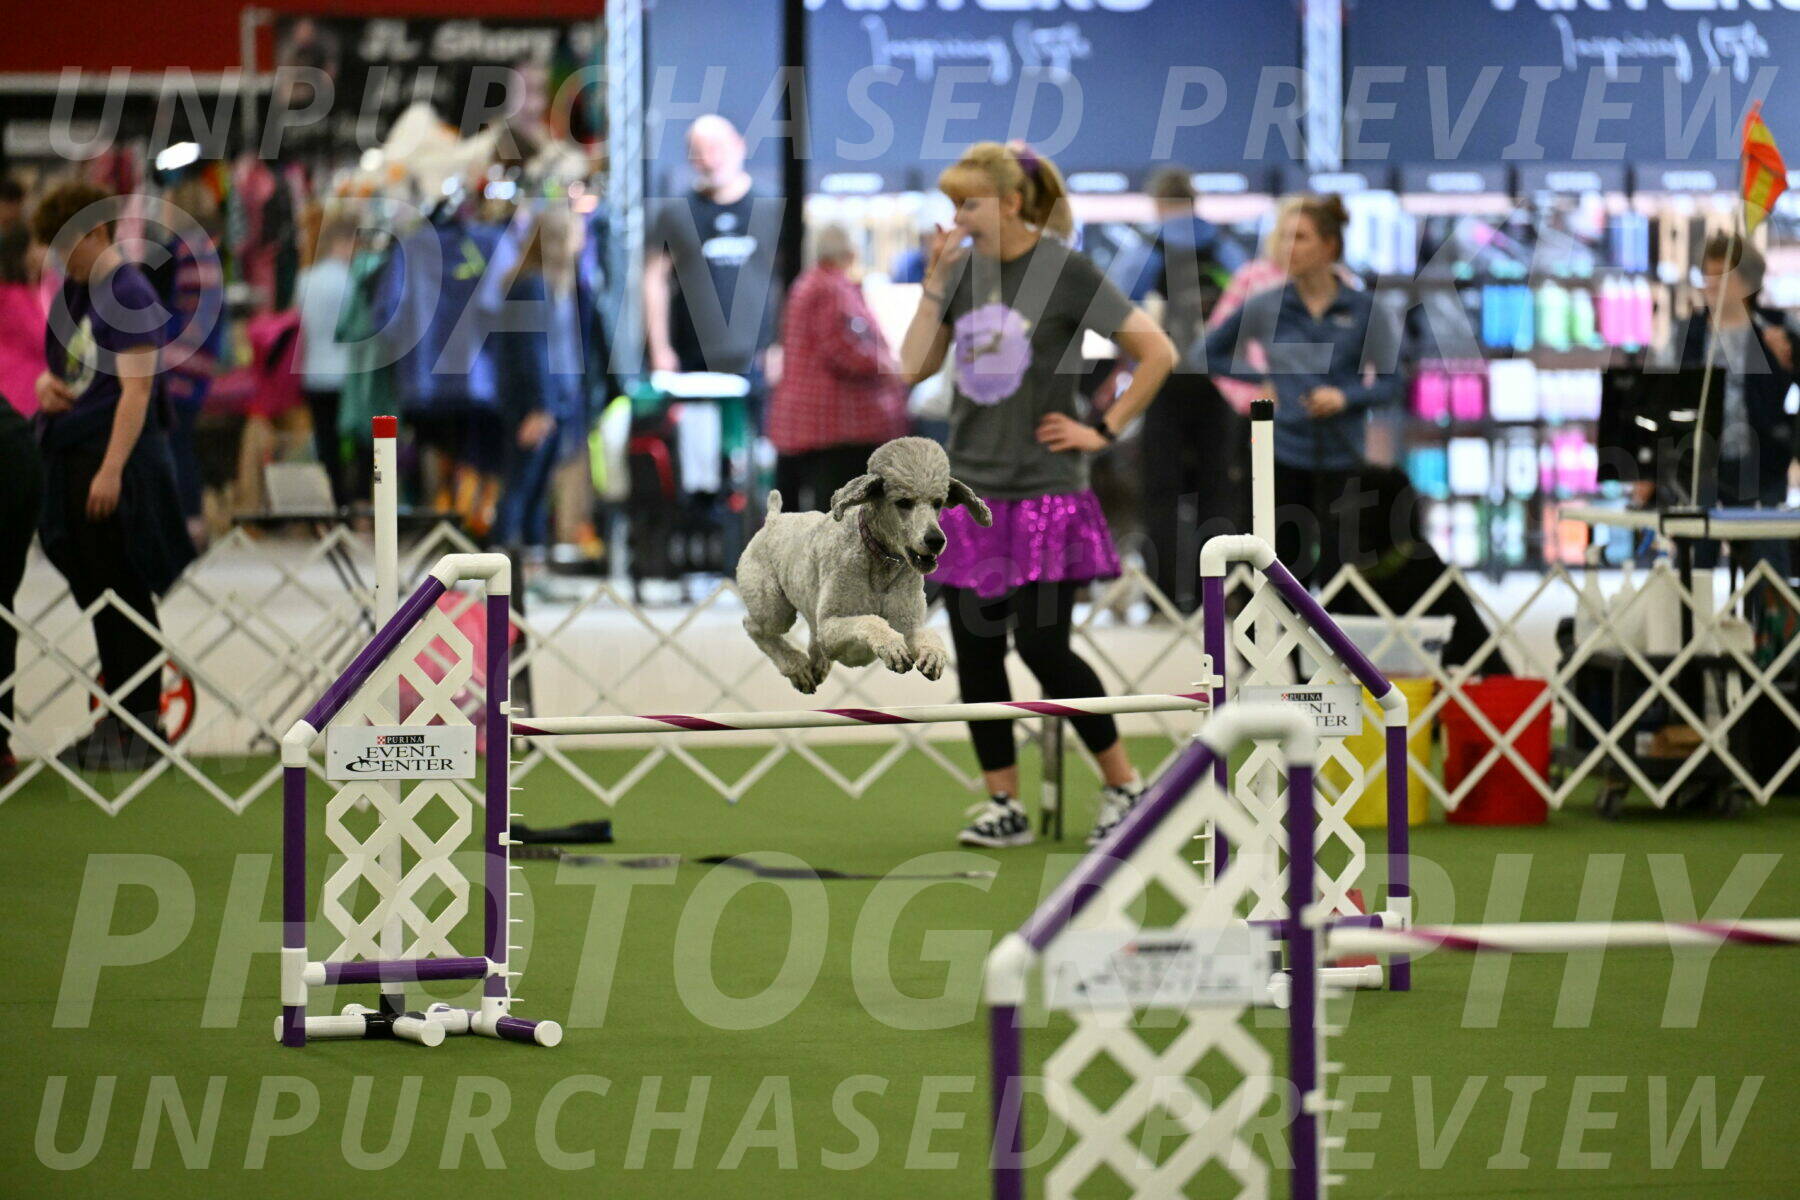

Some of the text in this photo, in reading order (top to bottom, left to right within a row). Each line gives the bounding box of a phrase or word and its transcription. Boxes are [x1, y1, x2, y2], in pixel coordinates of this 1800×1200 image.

[1289, 693, 1321, 701] PURINA
[386, 736, 424, 744] PURINA
[366, 745, 440, 758] EVENT
[345, 758, 454, 772] CENTER
